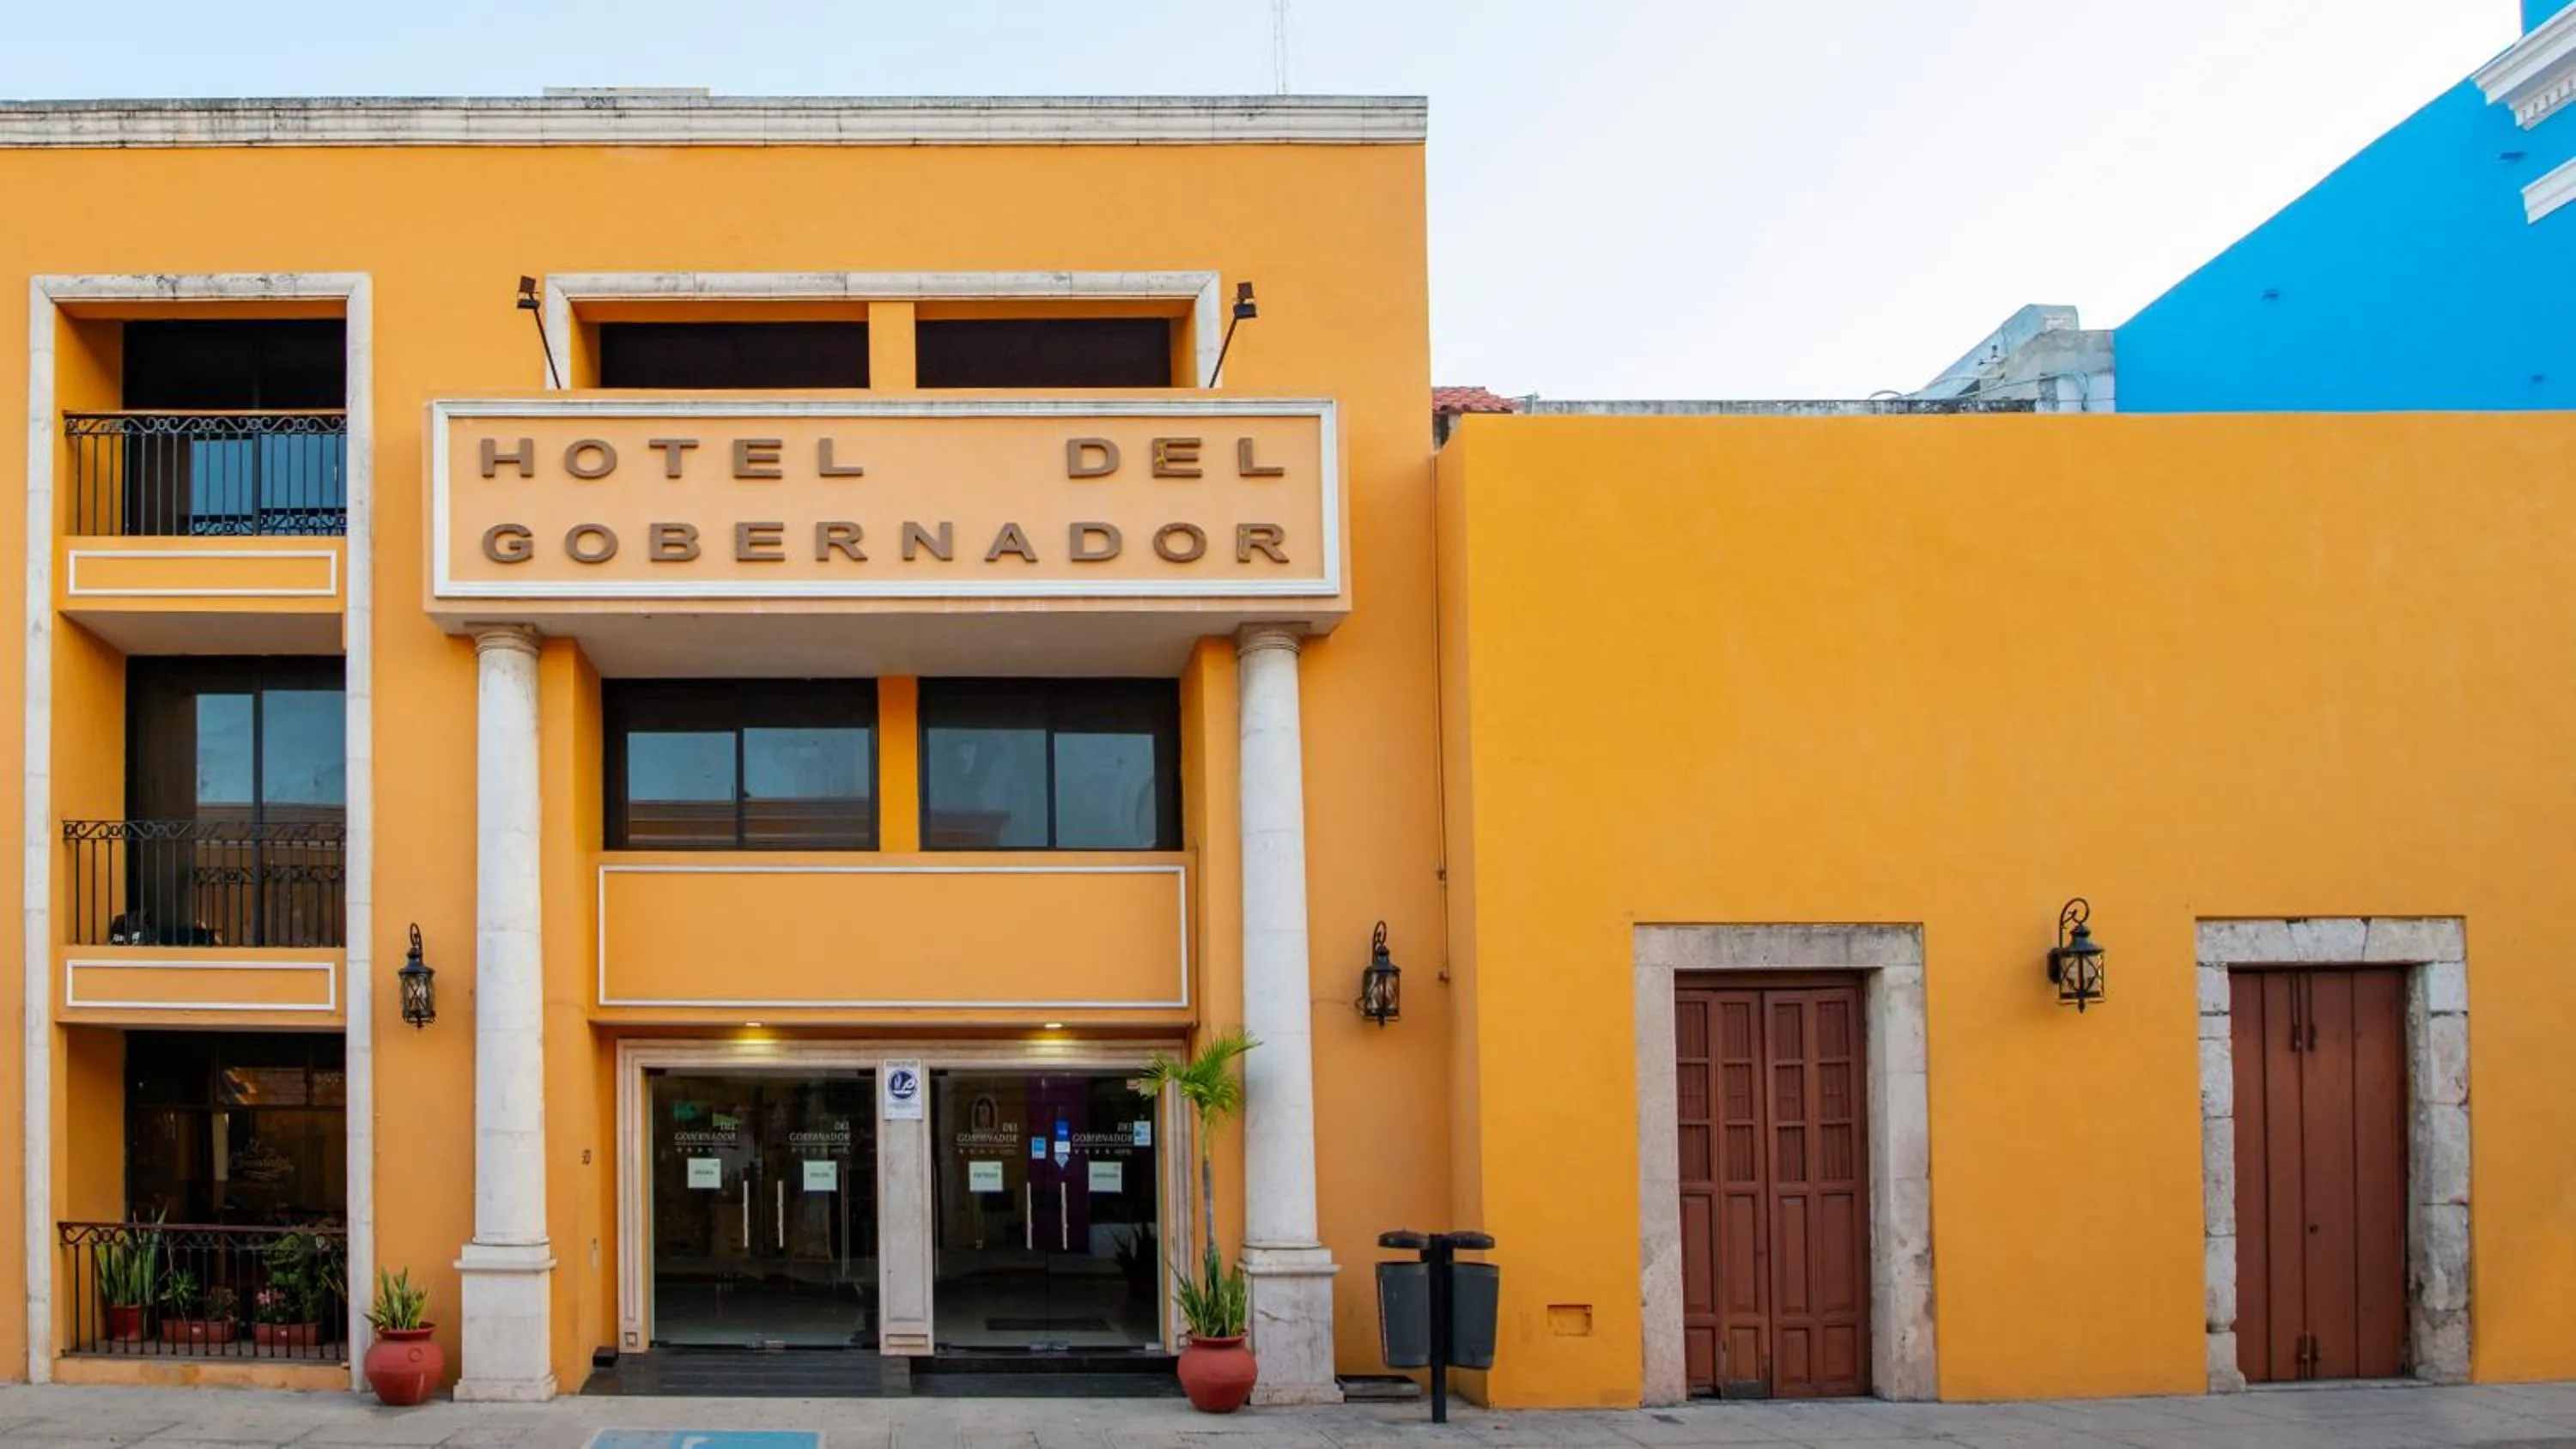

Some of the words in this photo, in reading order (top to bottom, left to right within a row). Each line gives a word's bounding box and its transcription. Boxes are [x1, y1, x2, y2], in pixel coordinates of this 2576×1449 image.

[480, 437, 864, 479] HOTEL
[1066, 437, 1285, 479] DEL
[482, 521, 1290, 564] GOBERNADOR
